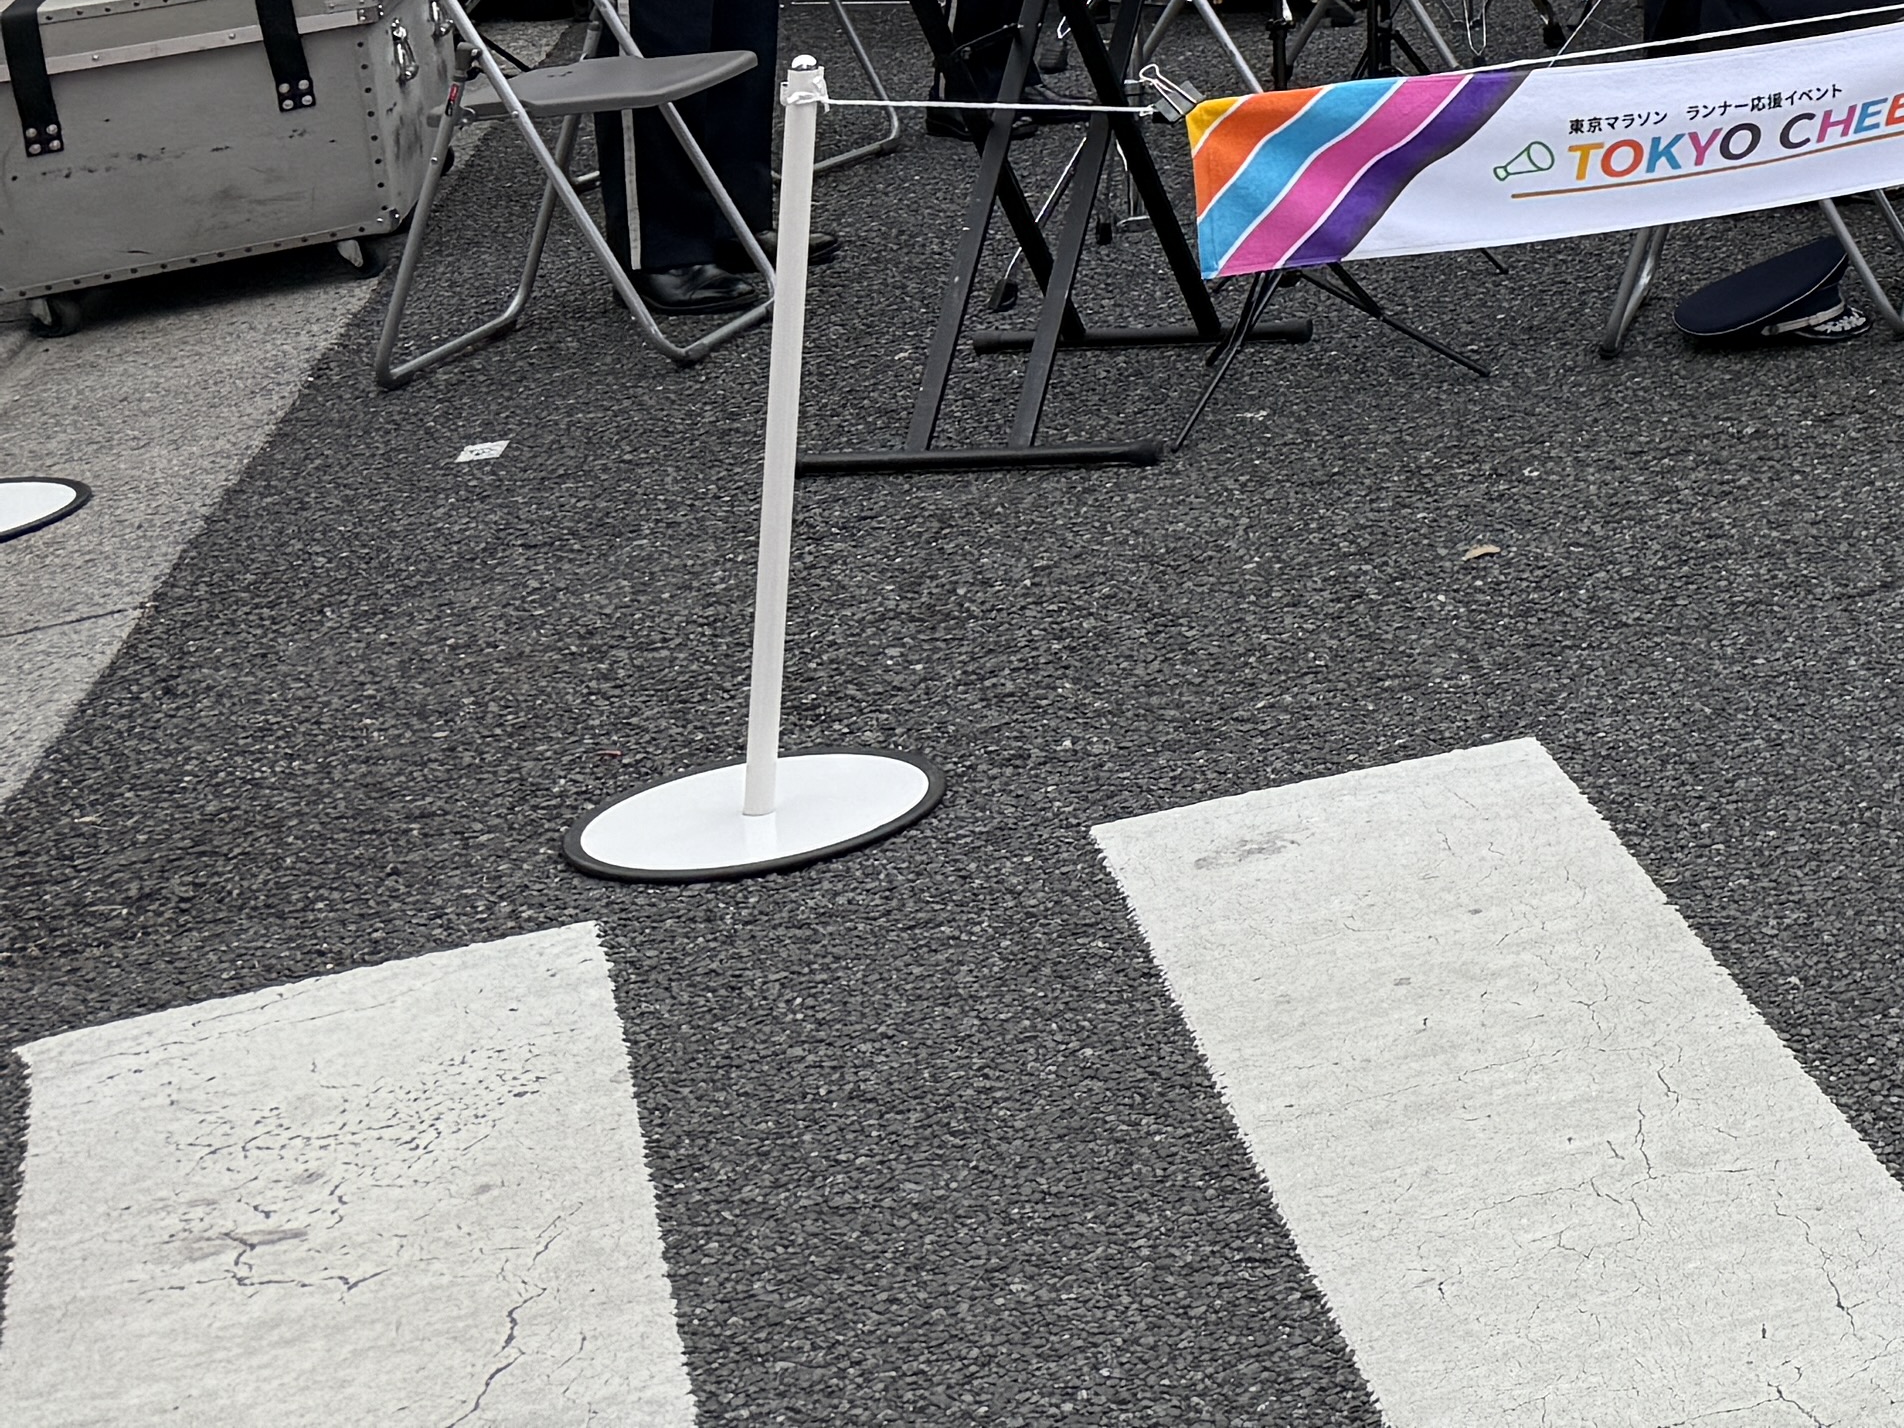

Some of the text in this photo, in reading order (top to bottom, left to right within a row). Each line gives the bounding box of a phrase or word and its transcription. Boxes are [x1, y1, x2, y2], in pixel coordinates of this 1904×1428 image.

[1569, 84, 1843, 135] 東京マラソン ランナー応援イベント
[1568, 122, 1762, 181] TOKYO
